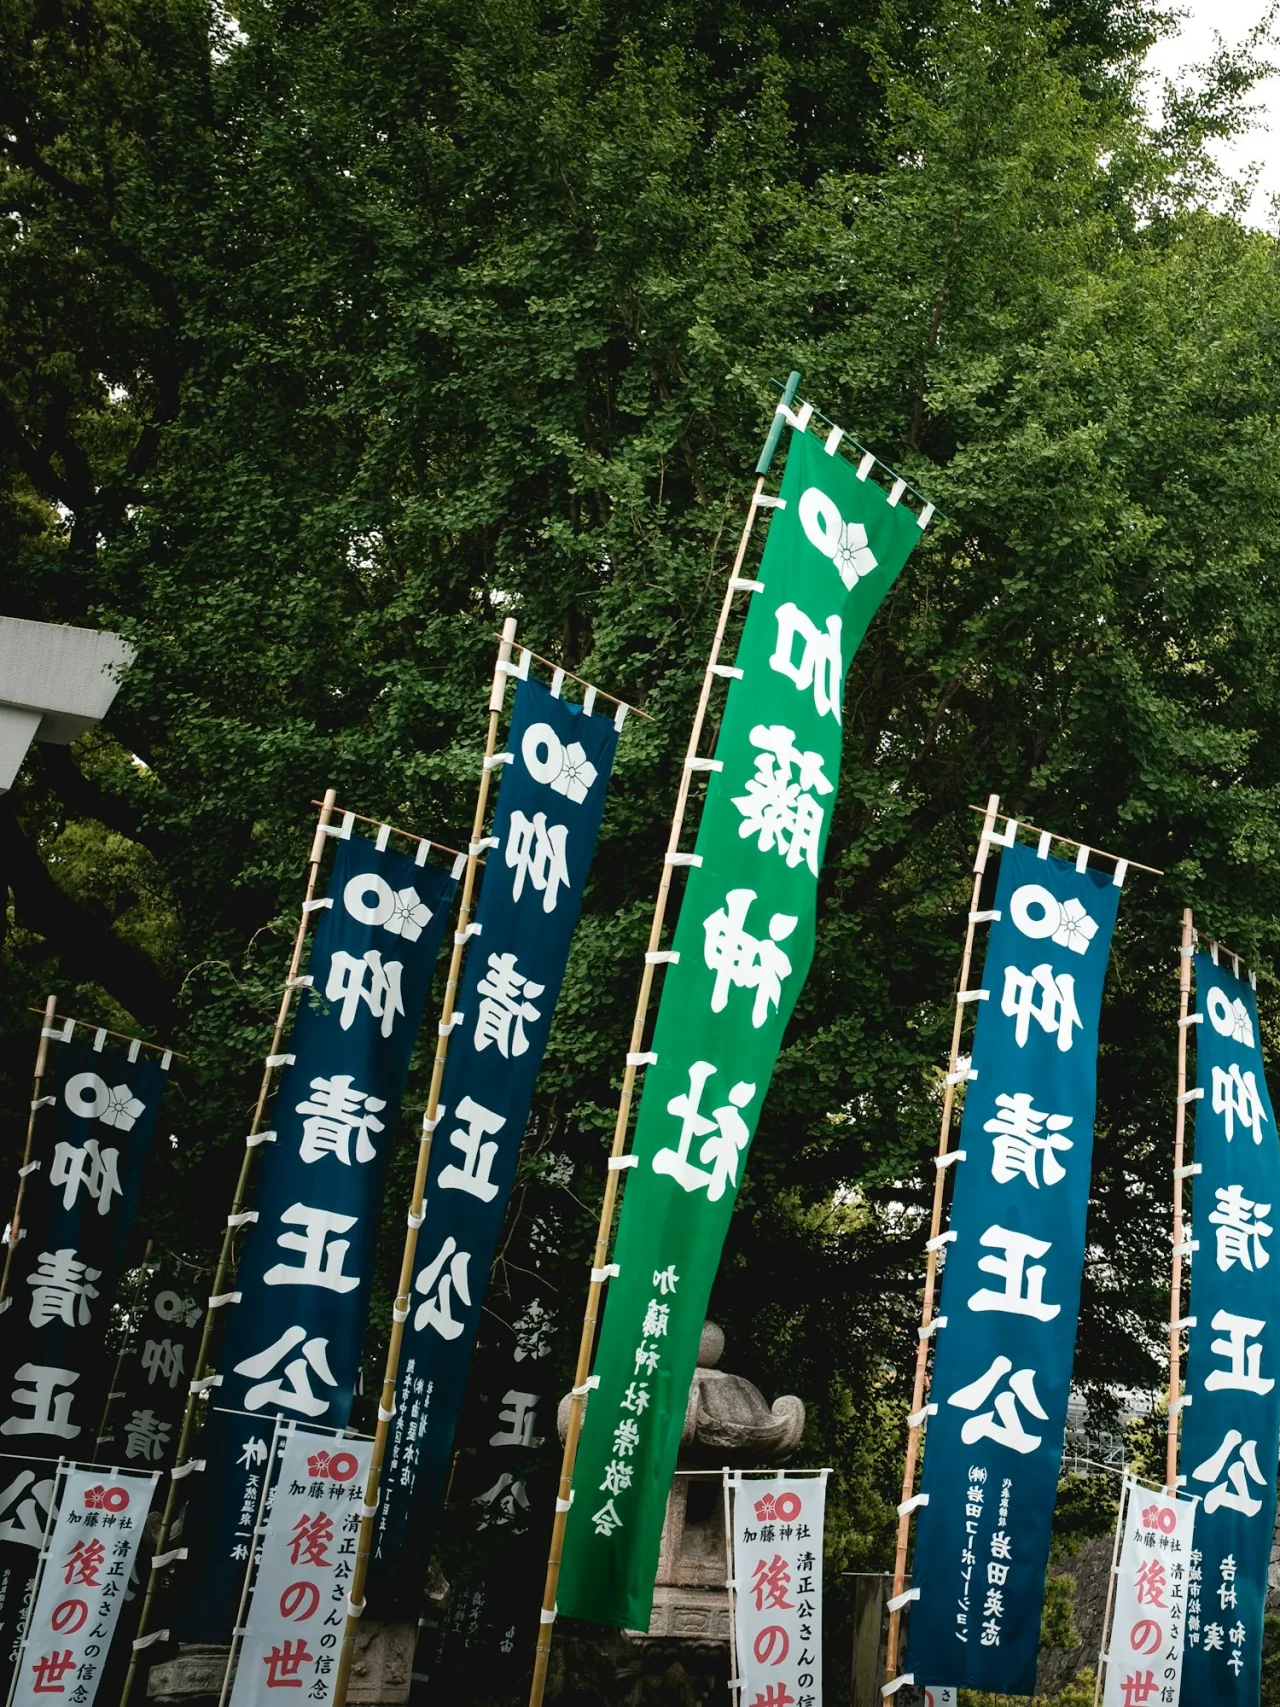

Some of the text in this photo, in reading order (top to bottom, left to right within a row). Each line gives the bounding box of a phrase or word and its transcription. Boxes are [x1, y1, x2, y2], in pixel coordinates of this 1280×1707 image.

[66, 1512, 133, 1529] 加藤神社
[287, 1479, 364, 1501] 加藤神社
[743, 1524, 811, 1543] 加藤神社
[1133, 1529, 1181, 1552] 加藤神社
[32, 1538, 106, 1693] 後の世
[69, 1540, 132, 1703] 清正公さんの信念
[263, 1511, 334, 1688] 後の世
[308, 1513, 361, 1700] 清正公さんの信念
[1120, 1559, 1169, 1707] 後の世
